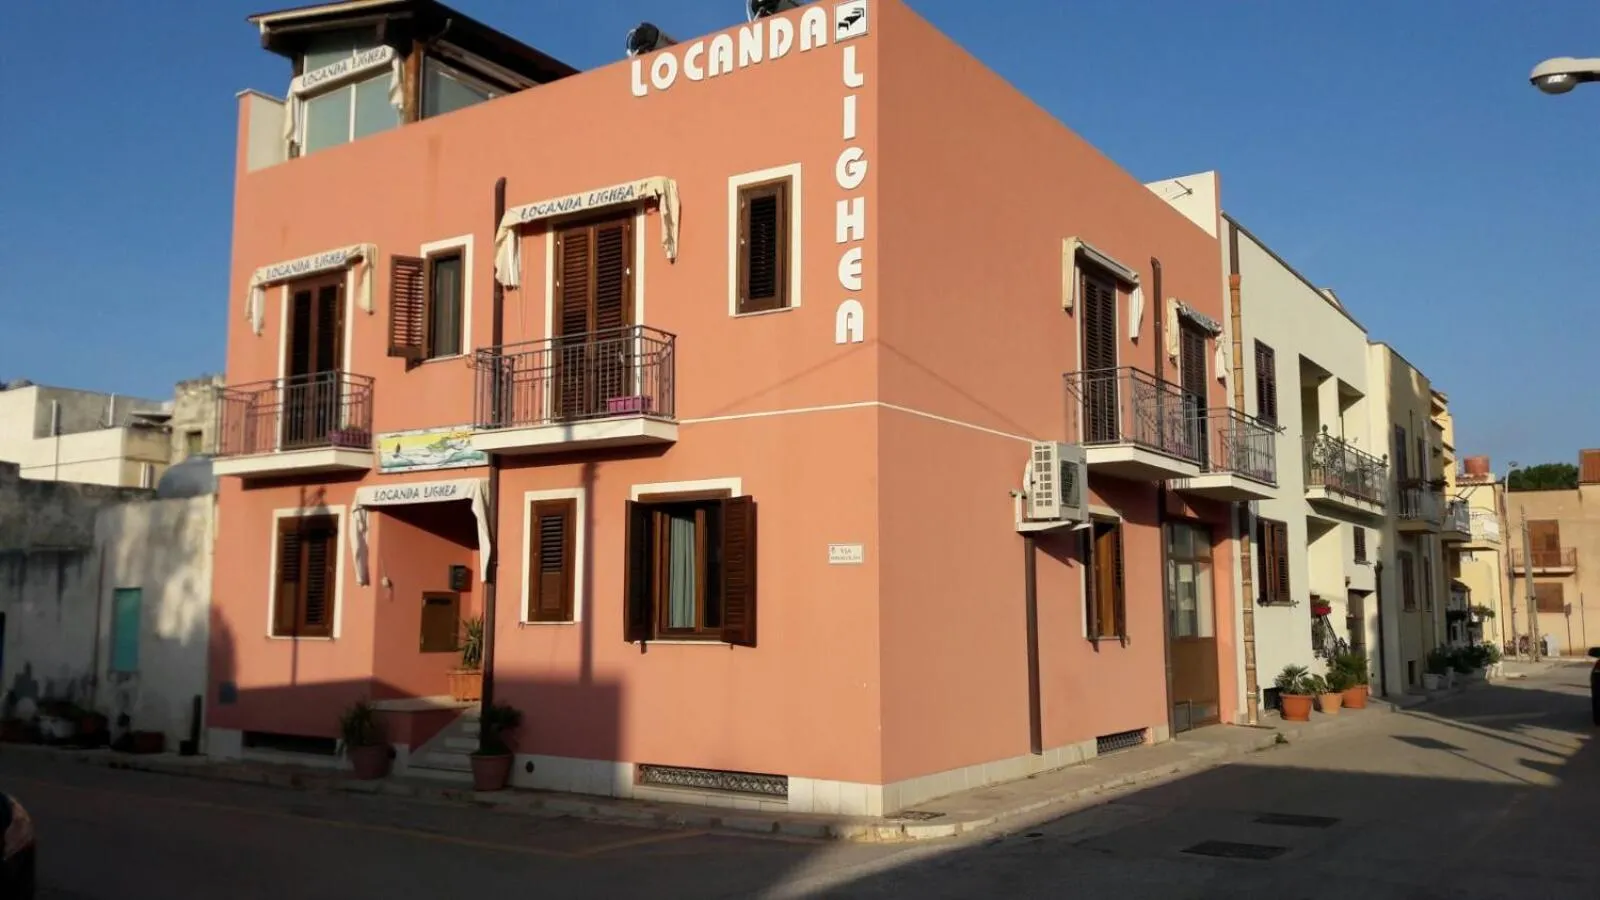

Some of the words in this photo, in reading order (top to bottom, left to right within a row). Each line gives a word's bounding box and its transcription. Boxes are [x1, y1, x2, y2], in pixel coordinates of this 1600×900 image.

[631, 6, 827, 97] LOCANDA
[521, 196, 582, 220] LOCANDA
[588, 184, 634, 206] LIGHEA
[835, 45, 868, 344] LIGHEA
[266, 260, 310, 279] LOCANDA
[374, 487, 419, 502] LOCANDA
[424, 484, 457, 498] LIGHEA
